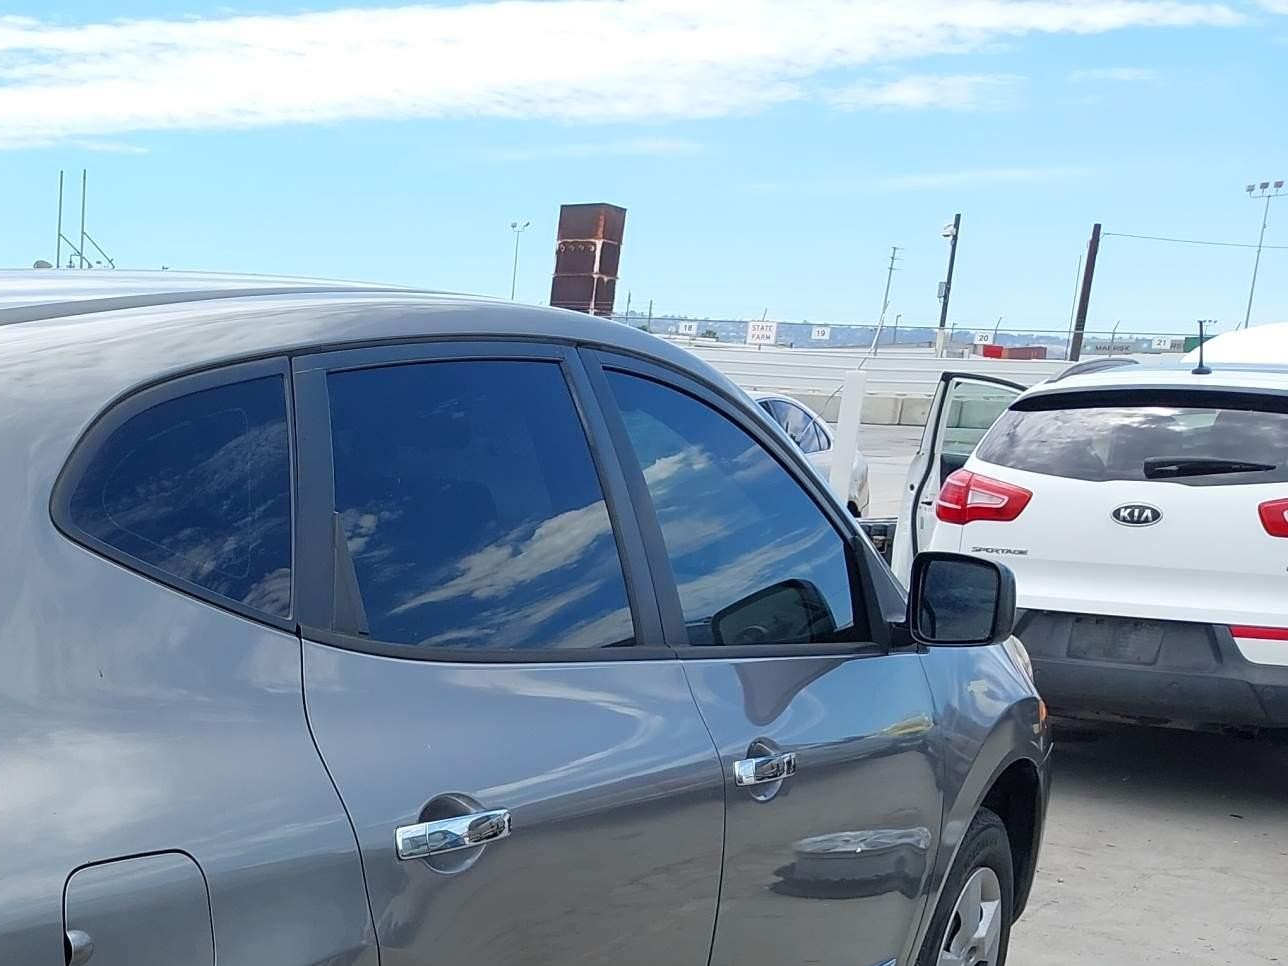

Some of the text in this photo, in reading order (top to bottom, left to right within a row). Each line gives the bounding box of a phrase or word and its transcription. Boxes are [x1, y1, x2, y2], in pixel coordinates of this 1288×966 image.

[752, 324, 773, 332] STATE
[752, 333, 771, 341] FARM
[816, 329, 826, 337] 19
[978, 334, 989, 342] 20
[1119, 508, 1153, 521] KIA
